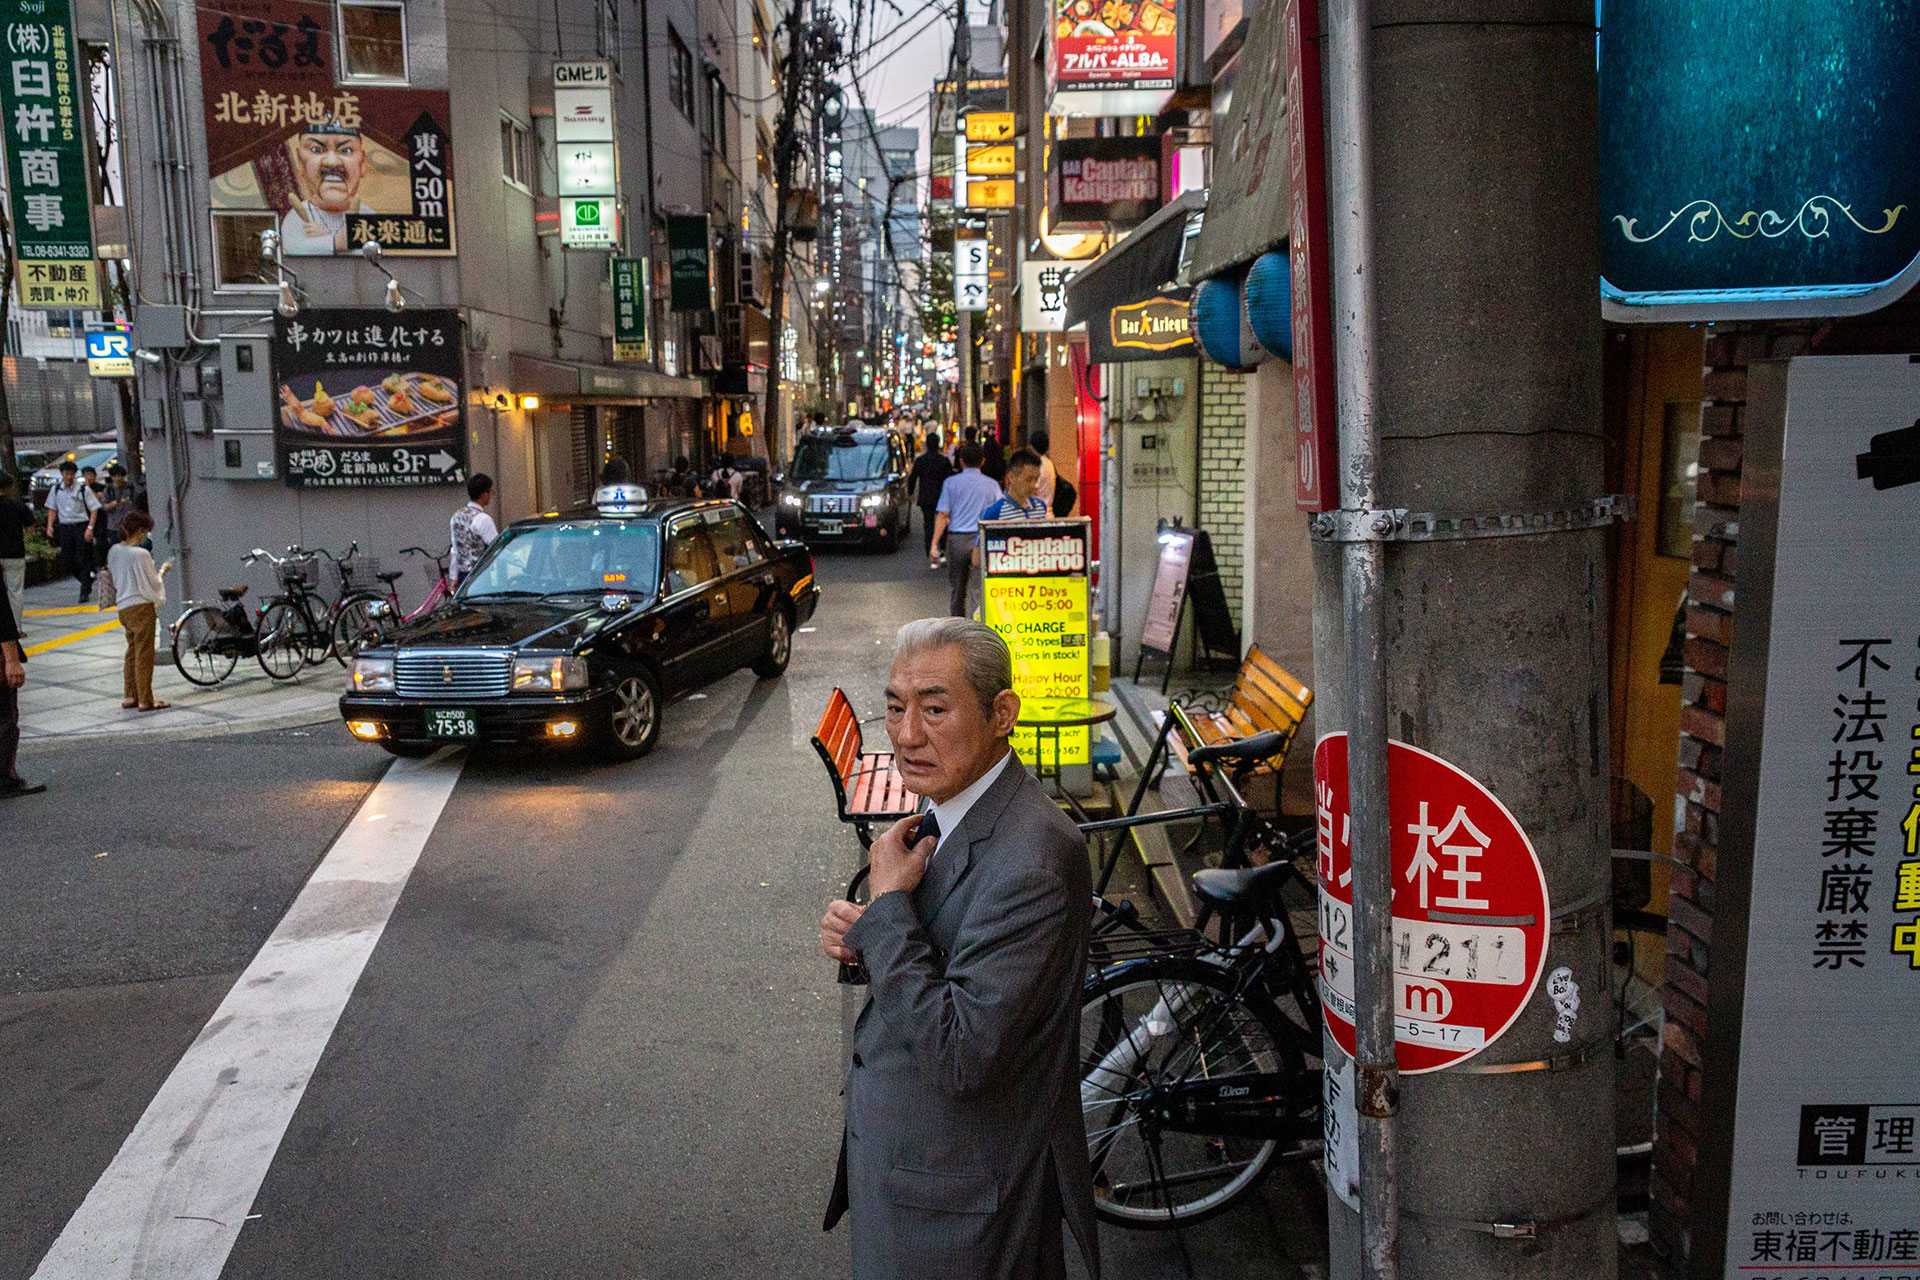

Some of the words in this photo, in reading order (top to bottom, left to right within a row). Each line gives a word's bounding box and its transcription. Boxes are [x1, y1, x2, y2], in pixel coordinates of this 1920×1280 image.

[20, 0, 45, 15] Syoji
[207, 14, 325, 69] だるま
[556, 66, 608, 82] GMビル
[215, 89, 362, 128] 北新地店
[1063, 160, 1081, 177] BAR
[1082, 156, 1158, 181] Captain
[1063, 177, 1158, 203] Kangaroo
[353, 219, 444, 244] 永楽通に
[27, 264, 87, 282] 不動産
[30, 286, 89, 302] 売買・仲介
[1121, 318, 1139, 335] Bar
[1152, 316, 1188, 333] Arlequ
[90, 335, 128, 357] JR
[286, 321, 444, 352] 串カツは進化する
[340, 451, 371, 463] だるま
[393, 448, 427, 474] 3F
[341, 462, 390, 475] 北新地店
[987, 540, 1006, 551] BAR
[1007, 536, 1083, 555] Captain
[988, 552, 1084, 574] Kangaroo
[990, 587, 1024, 598] OPEN
[1028, 585, 1036, 598] 7
[1040, 586, 1068, 598] Days
[995, 623, 1013, 634] NO
[1017, 622, 1066, 633] CHARGE
[1022, 637, 1034, 646] 50
[1036, 638, 1060, 647] types
[1042, 650, 1051, 659] in
[1013, 673, 1050, 685] Happy
[1054, 672, 1082, 683] Hour
[436, 719, 475, 735] 75-98
[1812, 639, 1892, 970] 不法投棄厳禁
[1405, 984, 1444, 1015] m
[1813, 1115, 1915, 1157] 管理
[1751, 1228, 1920, 1262] 東福不動産
